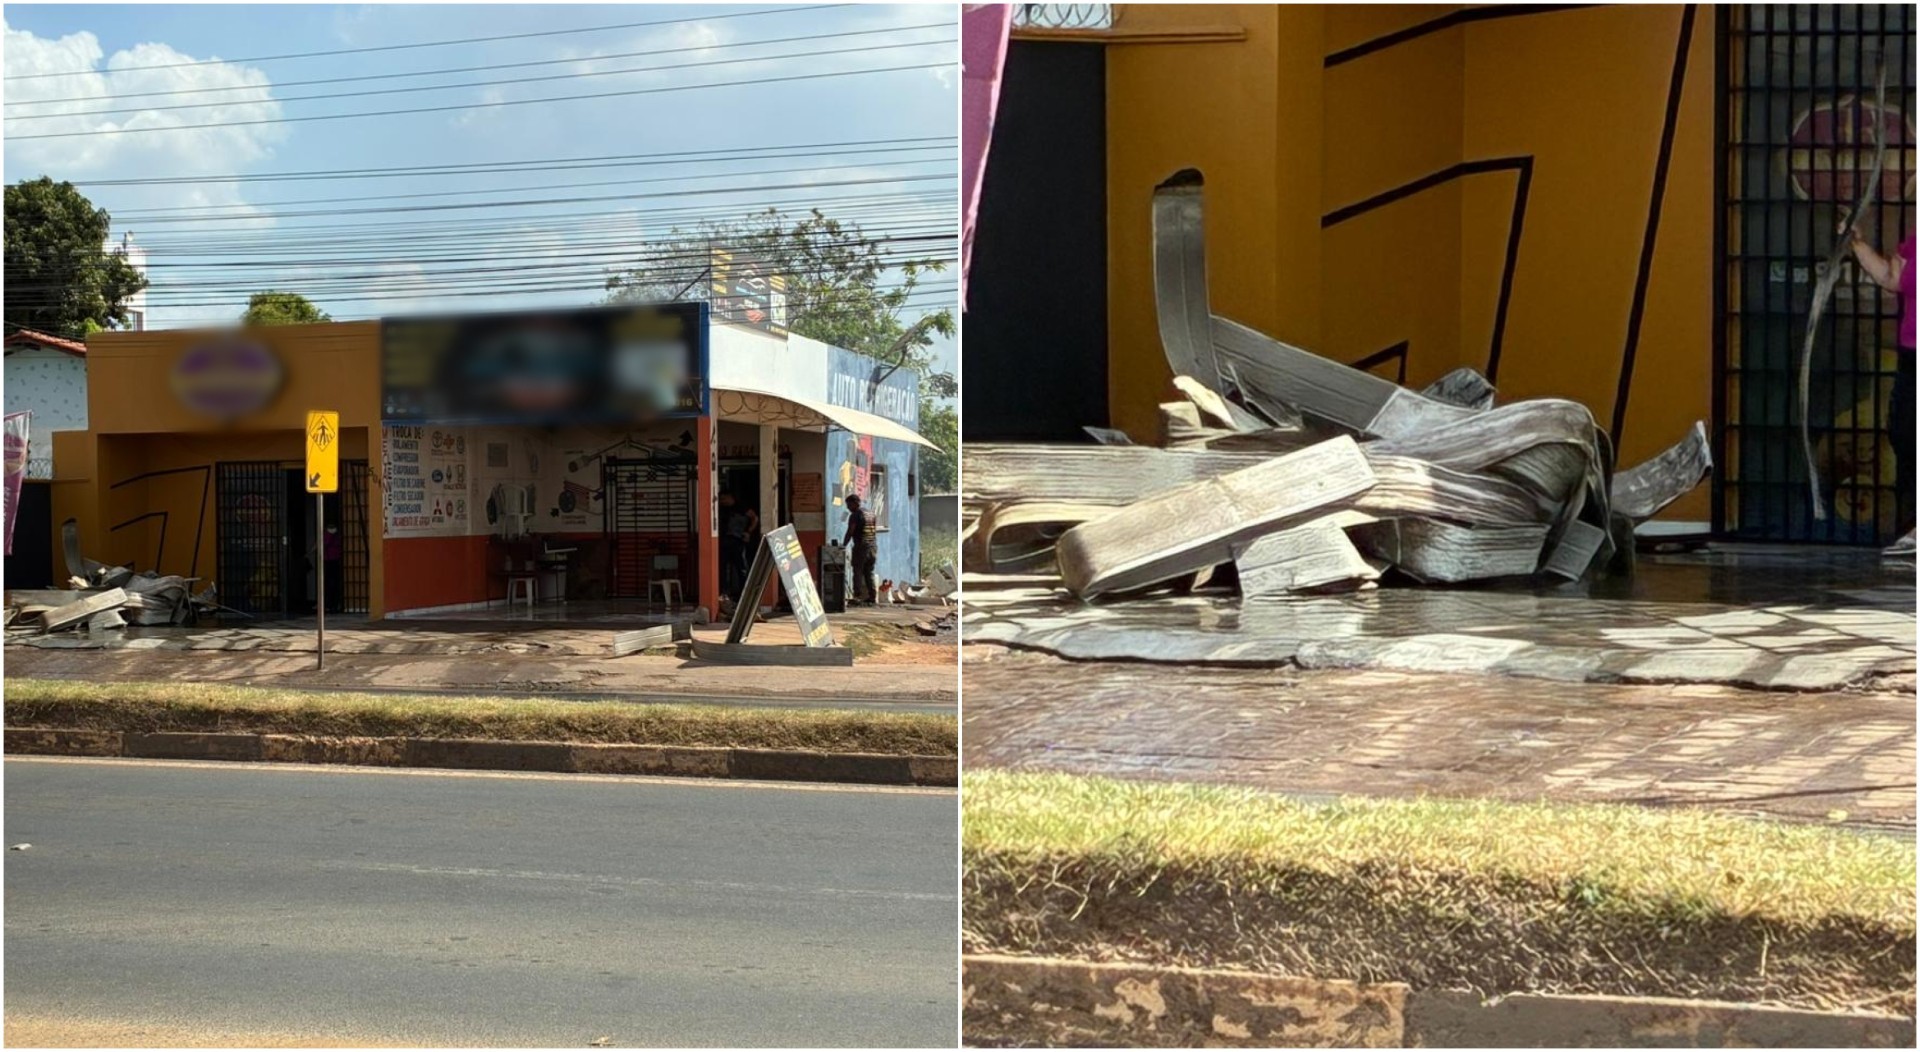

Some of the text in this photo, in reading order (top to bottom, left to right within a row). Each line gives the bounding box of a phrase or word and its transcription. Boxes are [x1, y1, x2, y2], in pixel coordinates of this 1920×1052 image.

[832, 372, 915, 424] AUTO RERIGERAÇÃO
[392, 425, 412, 439] TROCA
